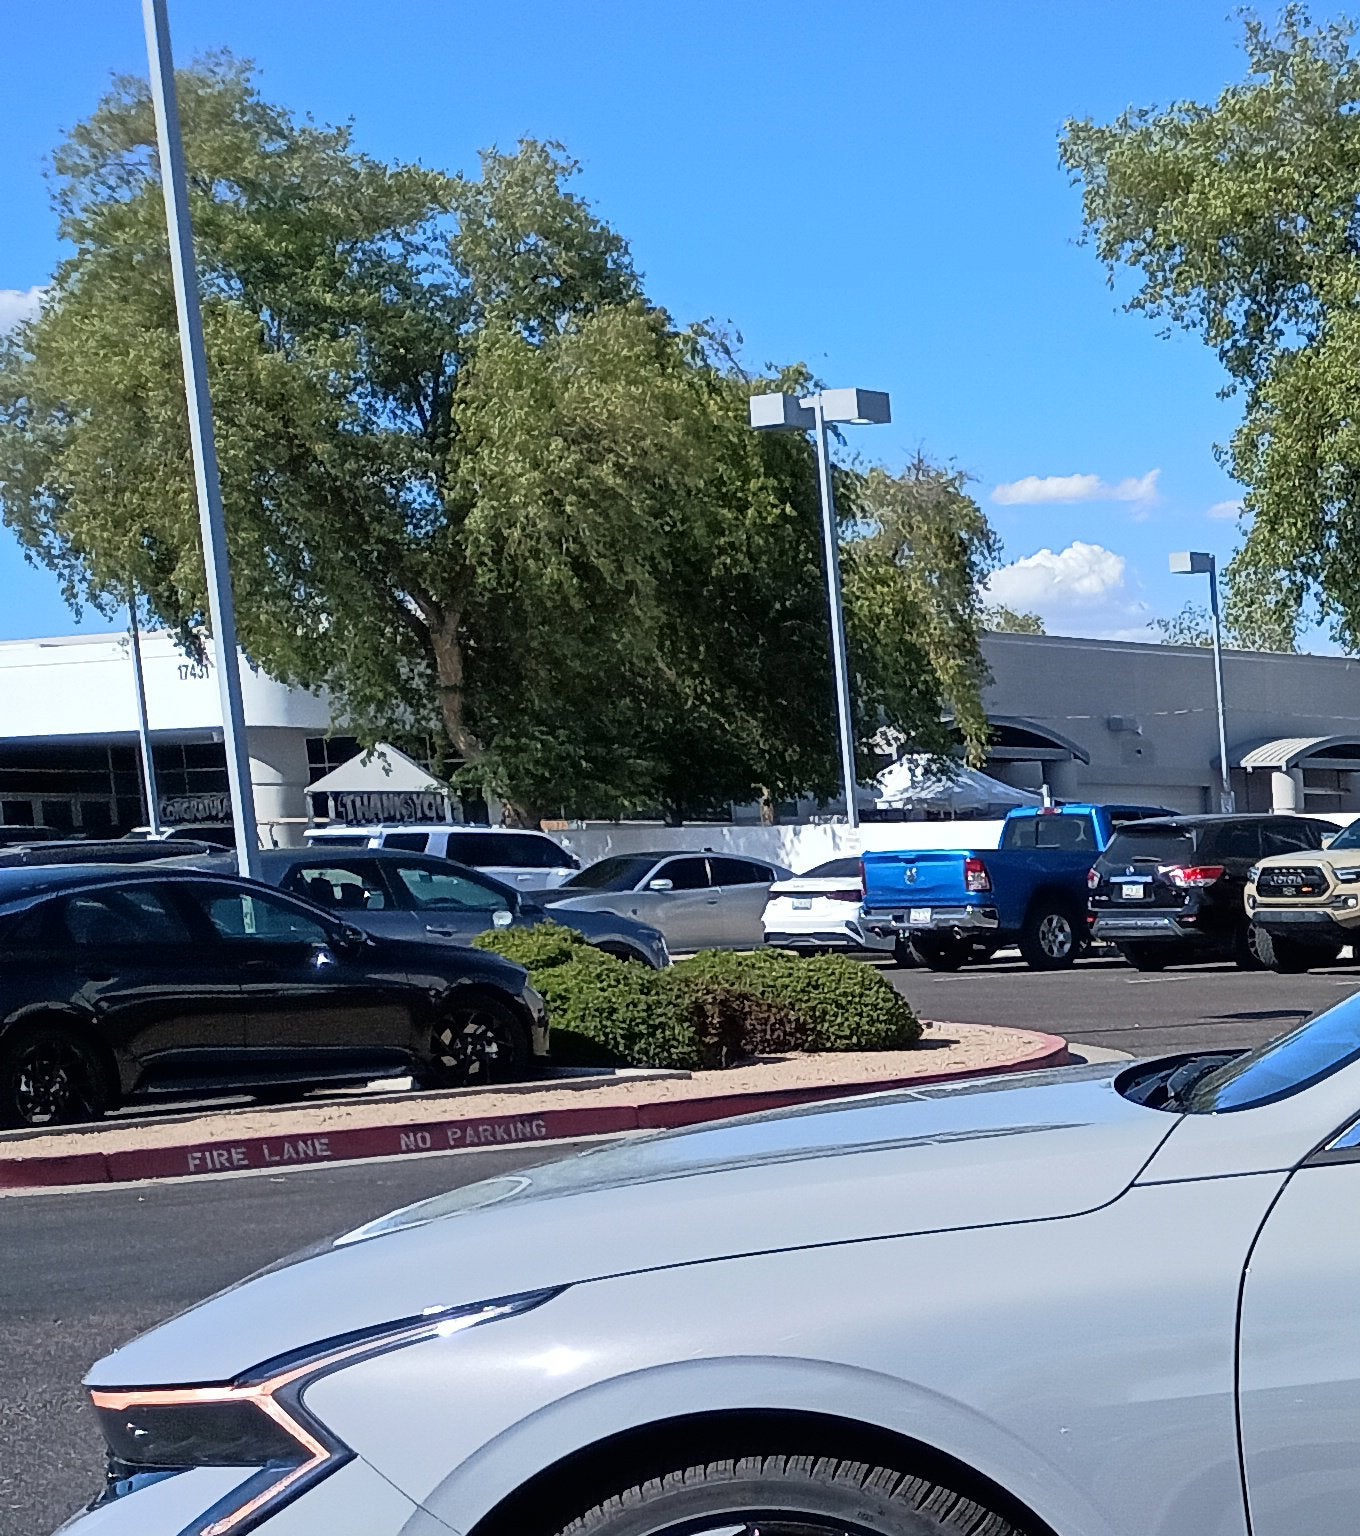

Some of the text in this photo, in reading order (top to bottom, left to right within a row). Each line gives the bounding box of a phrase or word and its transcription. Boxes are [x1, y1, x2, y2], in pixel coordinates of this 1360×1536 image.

[188, 1119, 547, 1172] FIRE LANE NO PARKING
